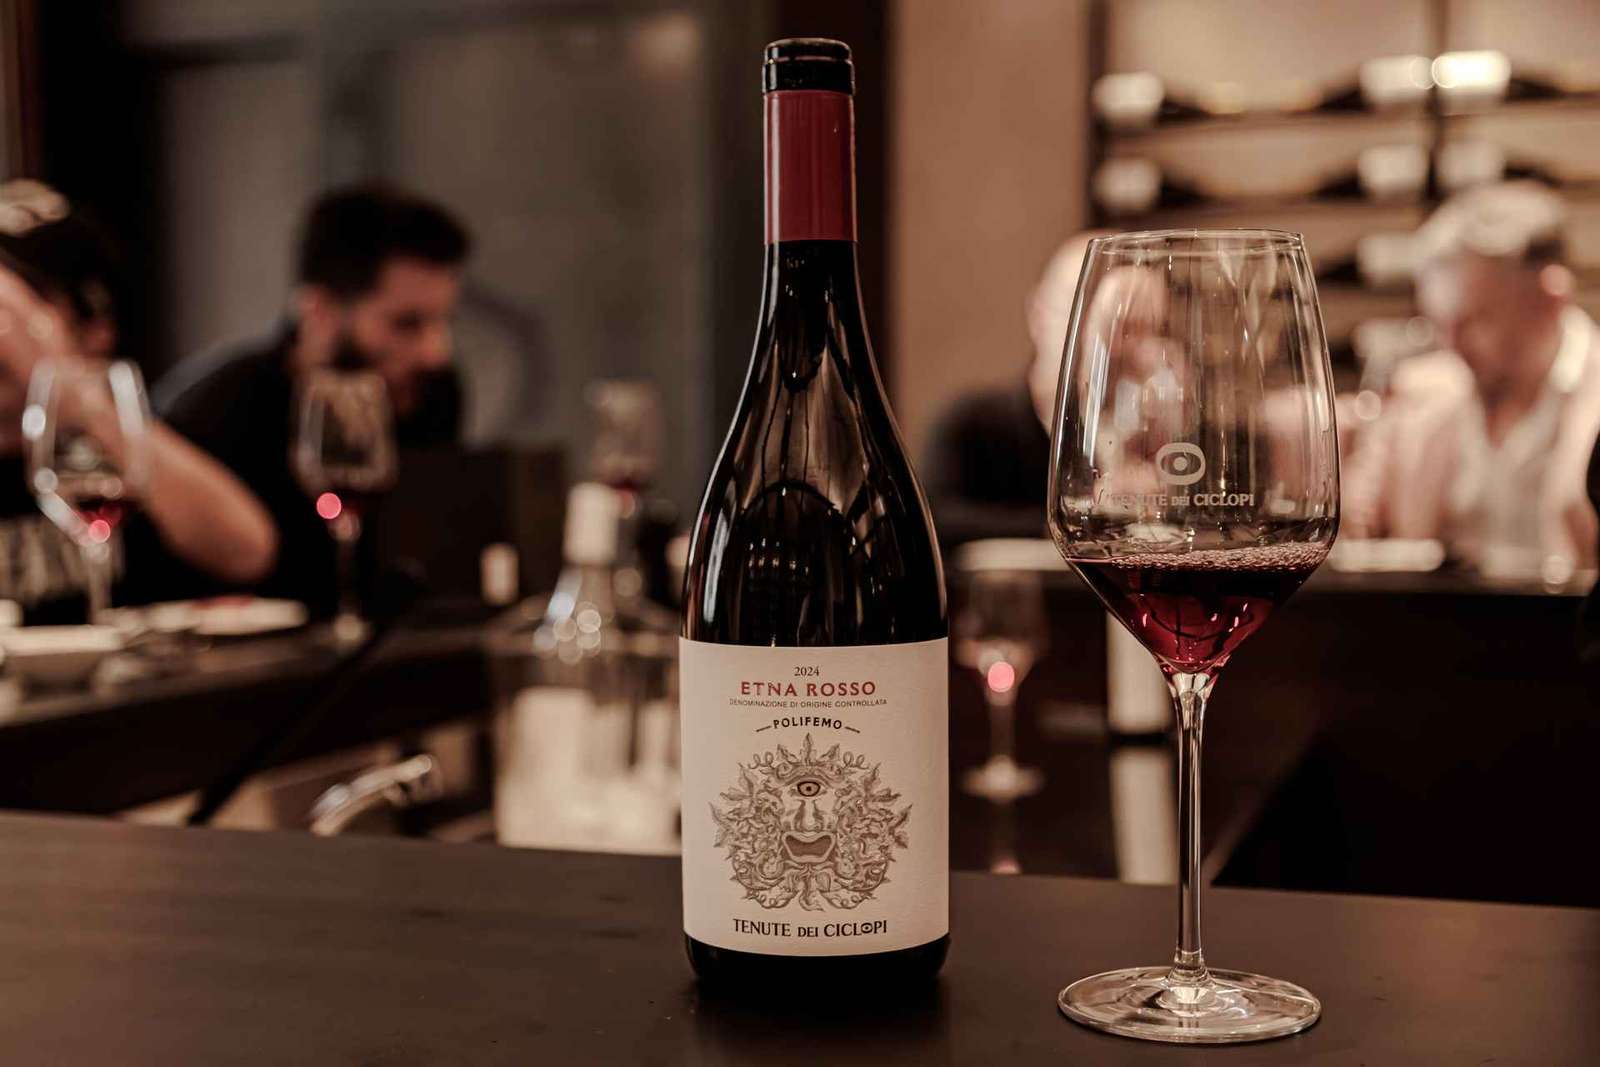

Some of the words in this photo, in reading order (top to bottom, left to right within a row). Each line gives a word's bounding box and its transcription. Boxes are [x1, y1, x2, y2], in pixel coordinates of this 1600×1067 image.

[1171, 496, 1190, 506] DEI
[1193, 494, 1255, 507] CICLOPI
[794, 665, 820, 677] 2024
[740, 681, 797, 697] ETNA
[806, 681, 876, 697] ROSSO
[729, 698, 788, 708] DENOMINAZIONE
[834, 698, 887, 707] CONTROLLATA
[773, 716, 843, 730] POLIFEMO
[732, 918, 791, 937] TENUTE
[797, 925, 819, 937] DEI
[823, 919, 888, 937] CICLOPI
